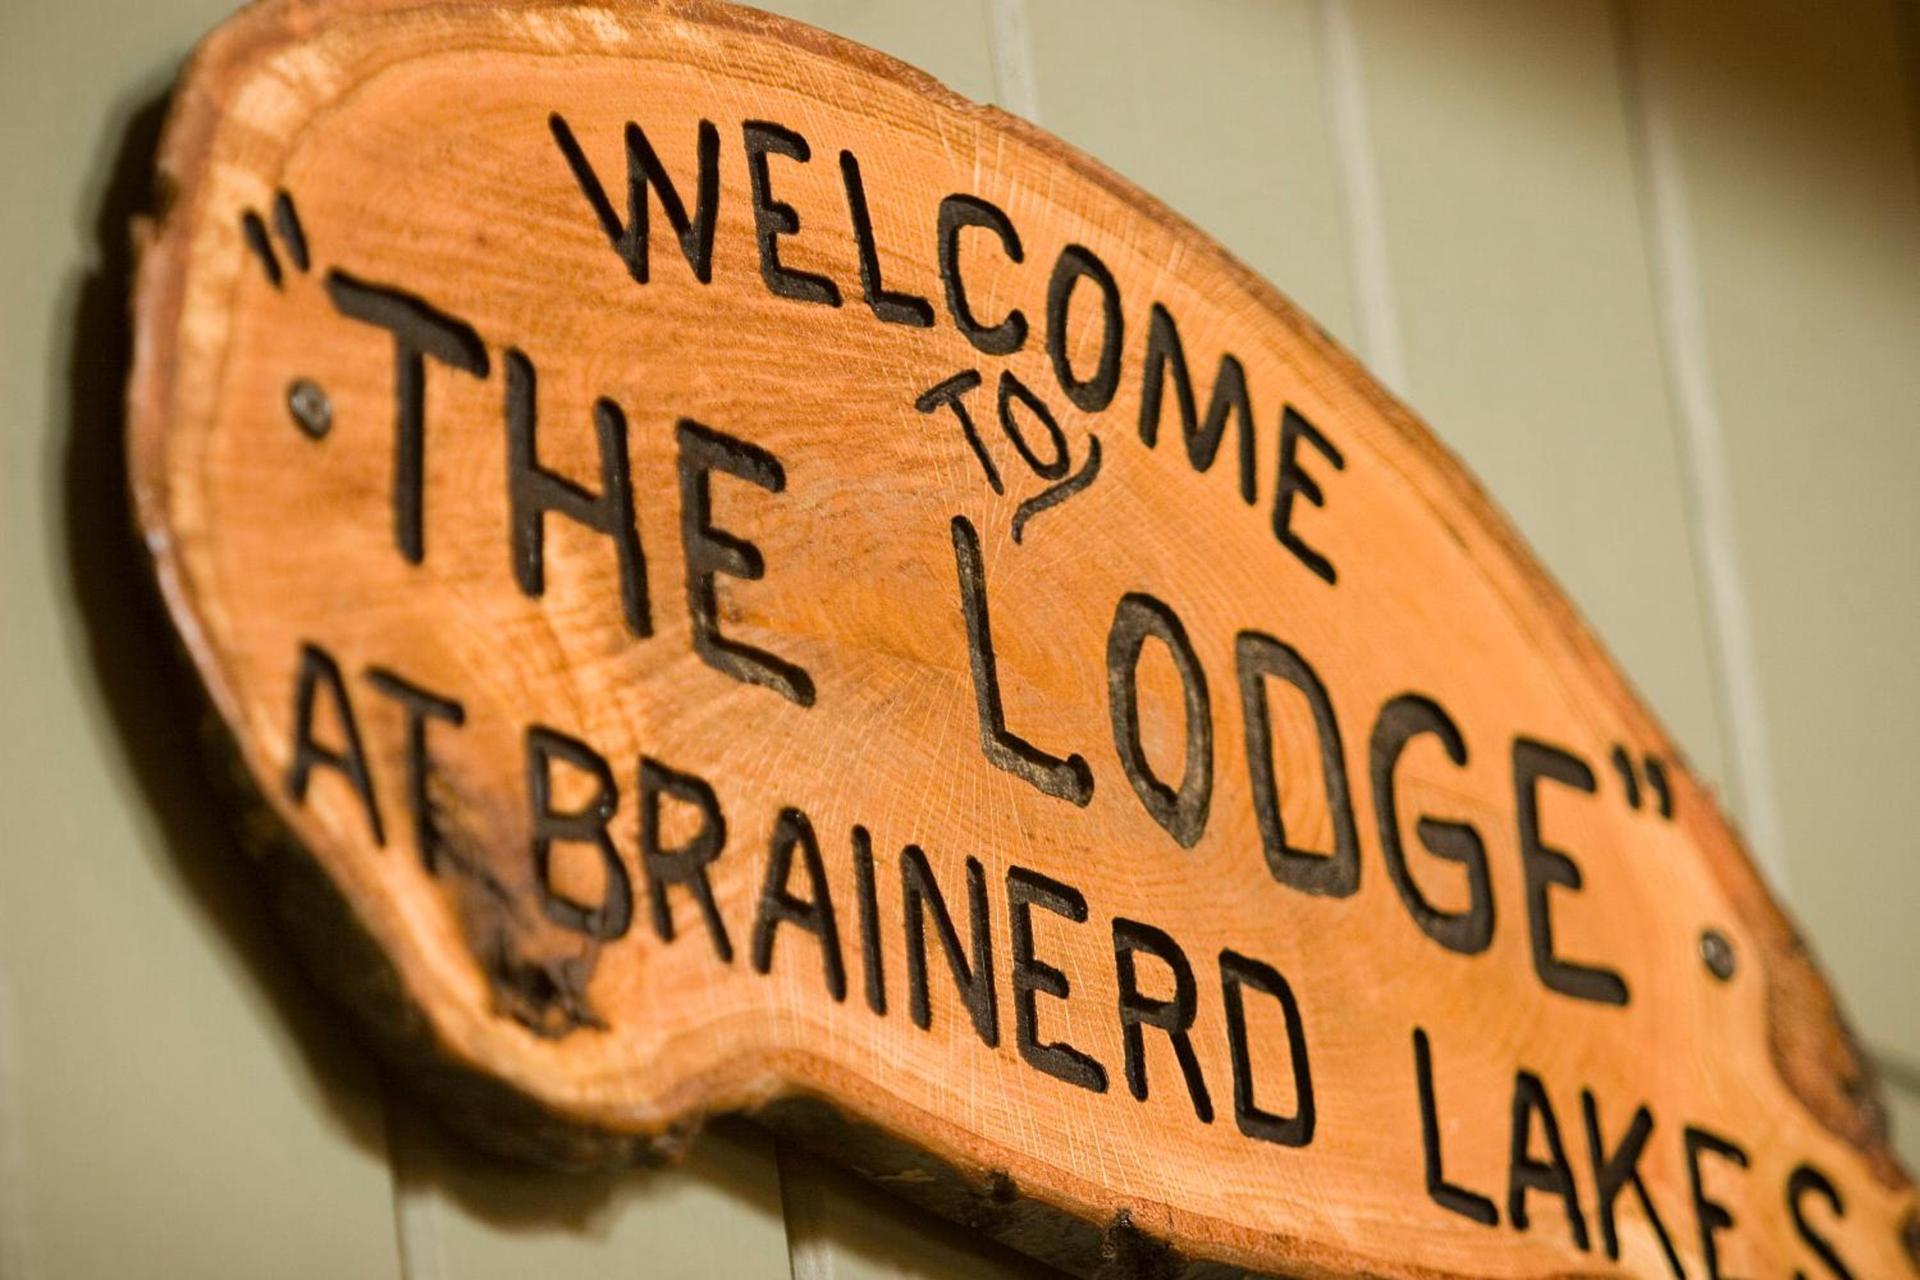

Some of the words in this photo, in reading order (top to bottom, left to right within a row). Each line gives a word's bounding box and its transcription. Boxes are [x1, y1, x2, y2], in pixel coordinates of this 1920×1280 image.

[548, 111, 1347, 586] WELCOME
[915, 370, 1071, 495] TO
[241, 186, 815, 707] "THE
[952, 515, 1674, 1008] LODGE"
[289, 640, 466, 875] AT
[526, 723, 1315, 1148] BRAINERD
